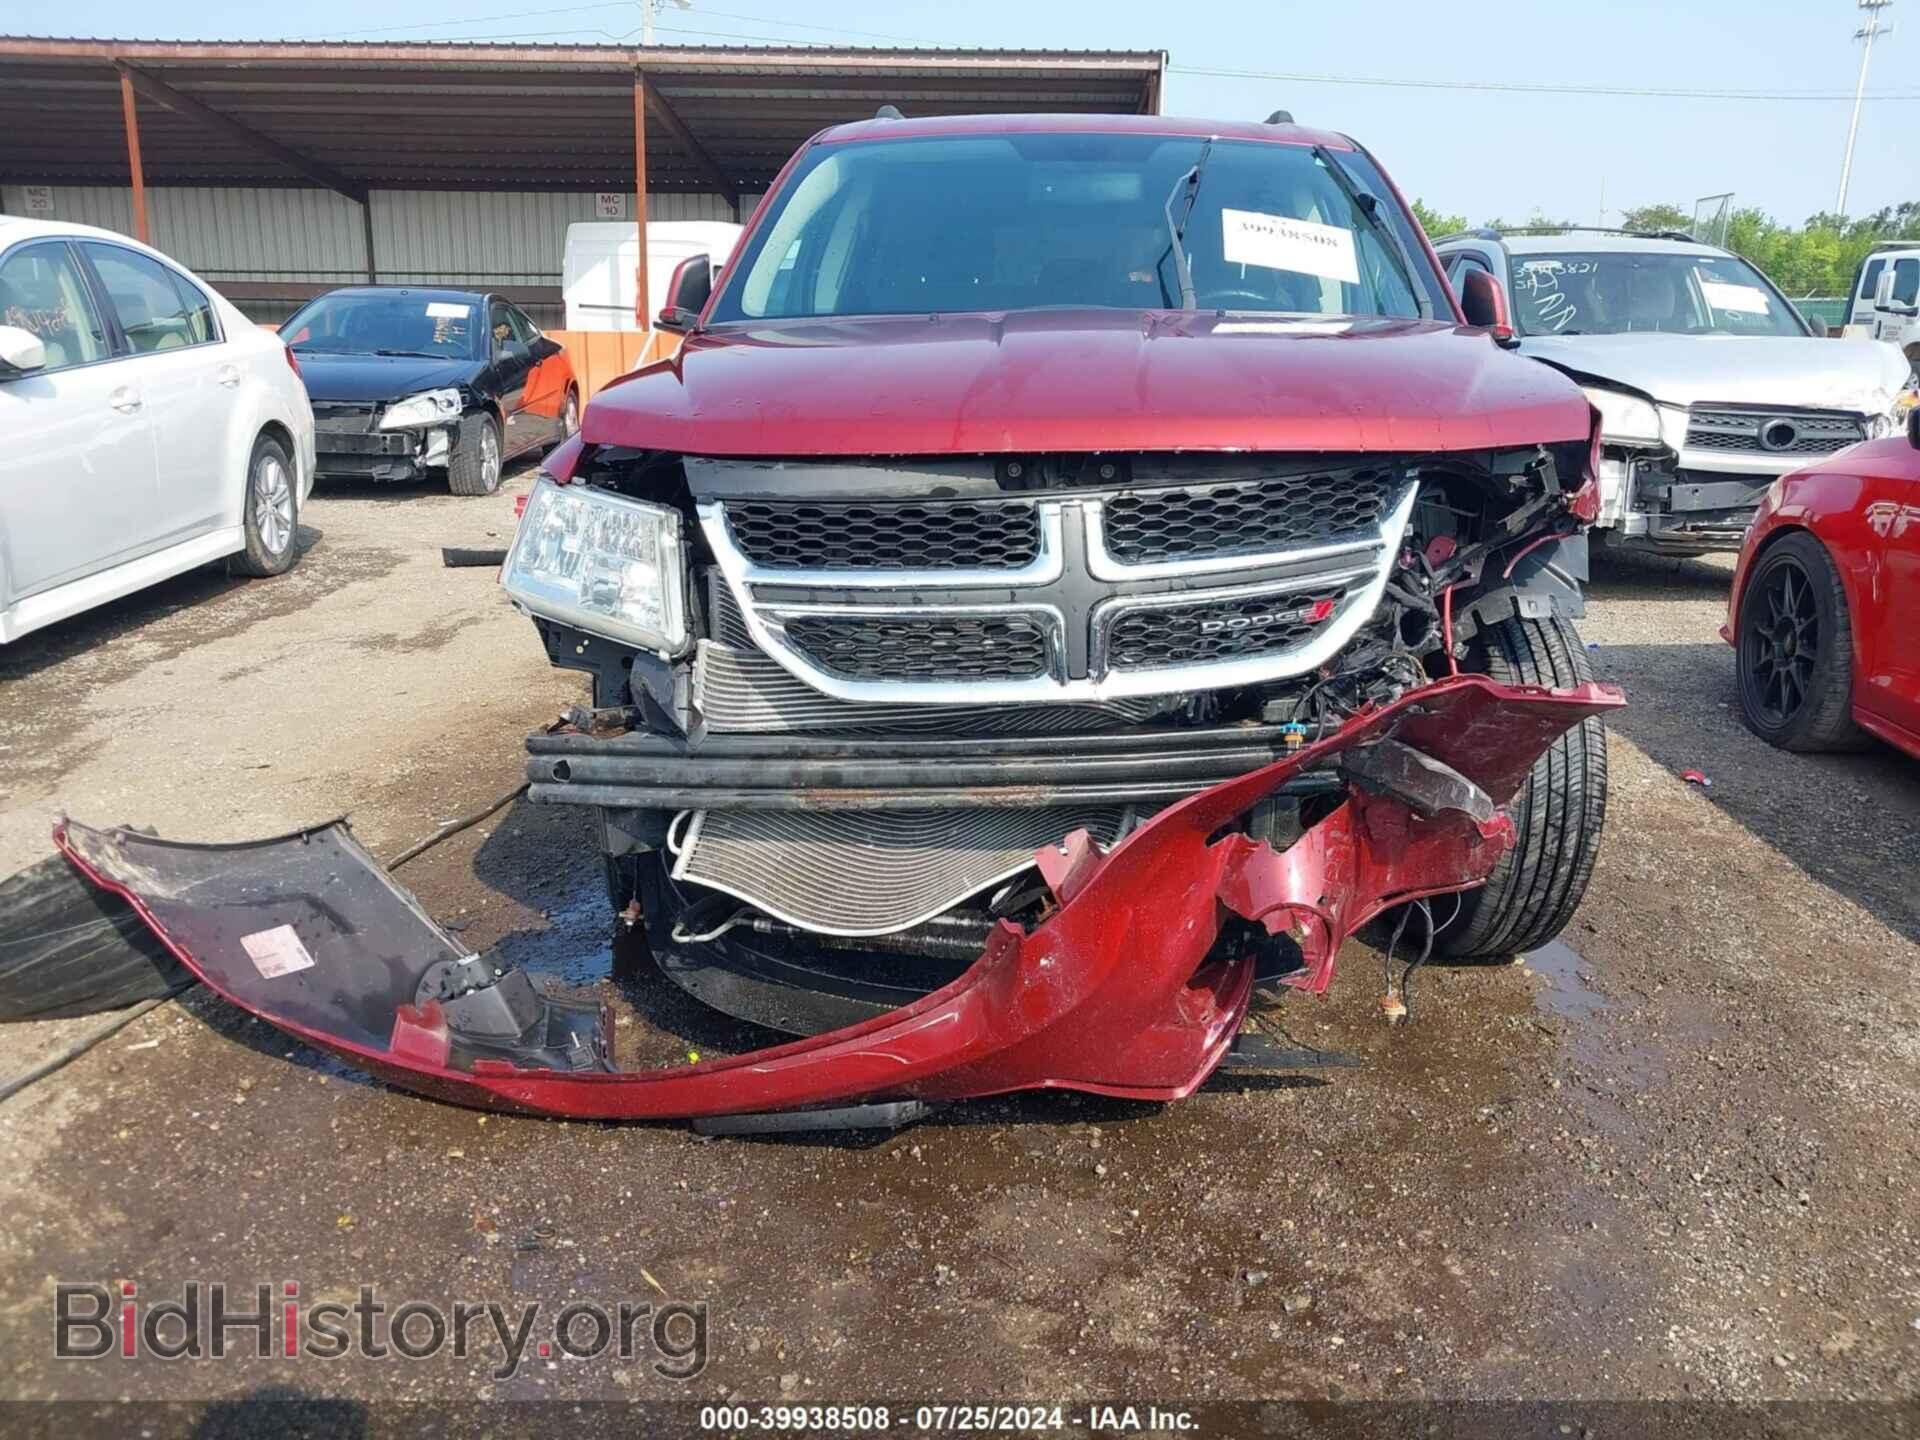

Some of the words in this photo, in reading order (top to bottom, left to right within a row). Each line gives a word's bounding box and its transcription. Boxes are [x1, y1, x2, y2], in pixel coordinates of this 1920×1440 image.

[601, 194, 620, 204] MC
[604, 206, 618, 216] 10
[1201, 608, 1316, 634] DODGE
